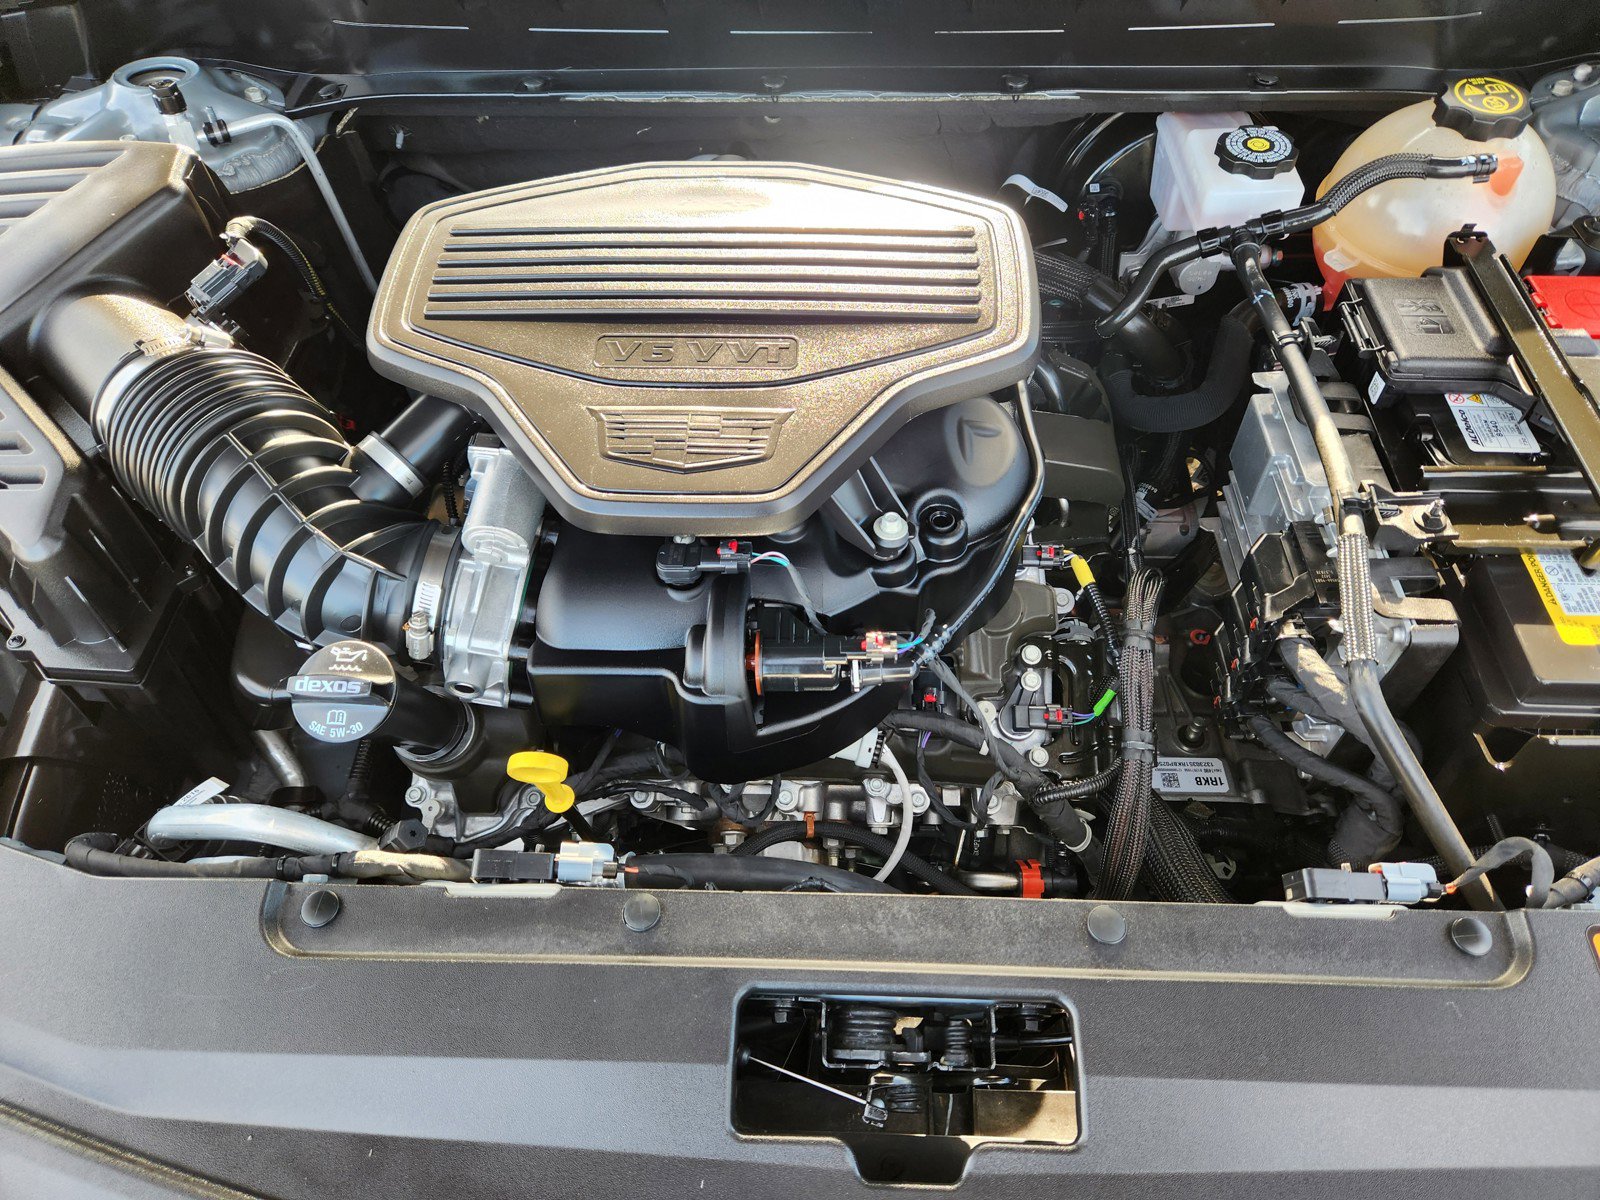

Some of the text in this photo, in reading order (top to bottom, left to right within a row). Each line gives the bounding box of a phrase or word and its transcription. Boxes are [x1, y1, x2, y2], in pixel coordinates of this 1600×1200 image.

[605, 340, 790, 363] V6 VVT
[1534, 568, 1554, 599] DANGER
[294, 676, 361, 694] dexos
[309, 720, 363, 738] SAE 5W-30
[1194, 776, 1224, 787] 1RKB
